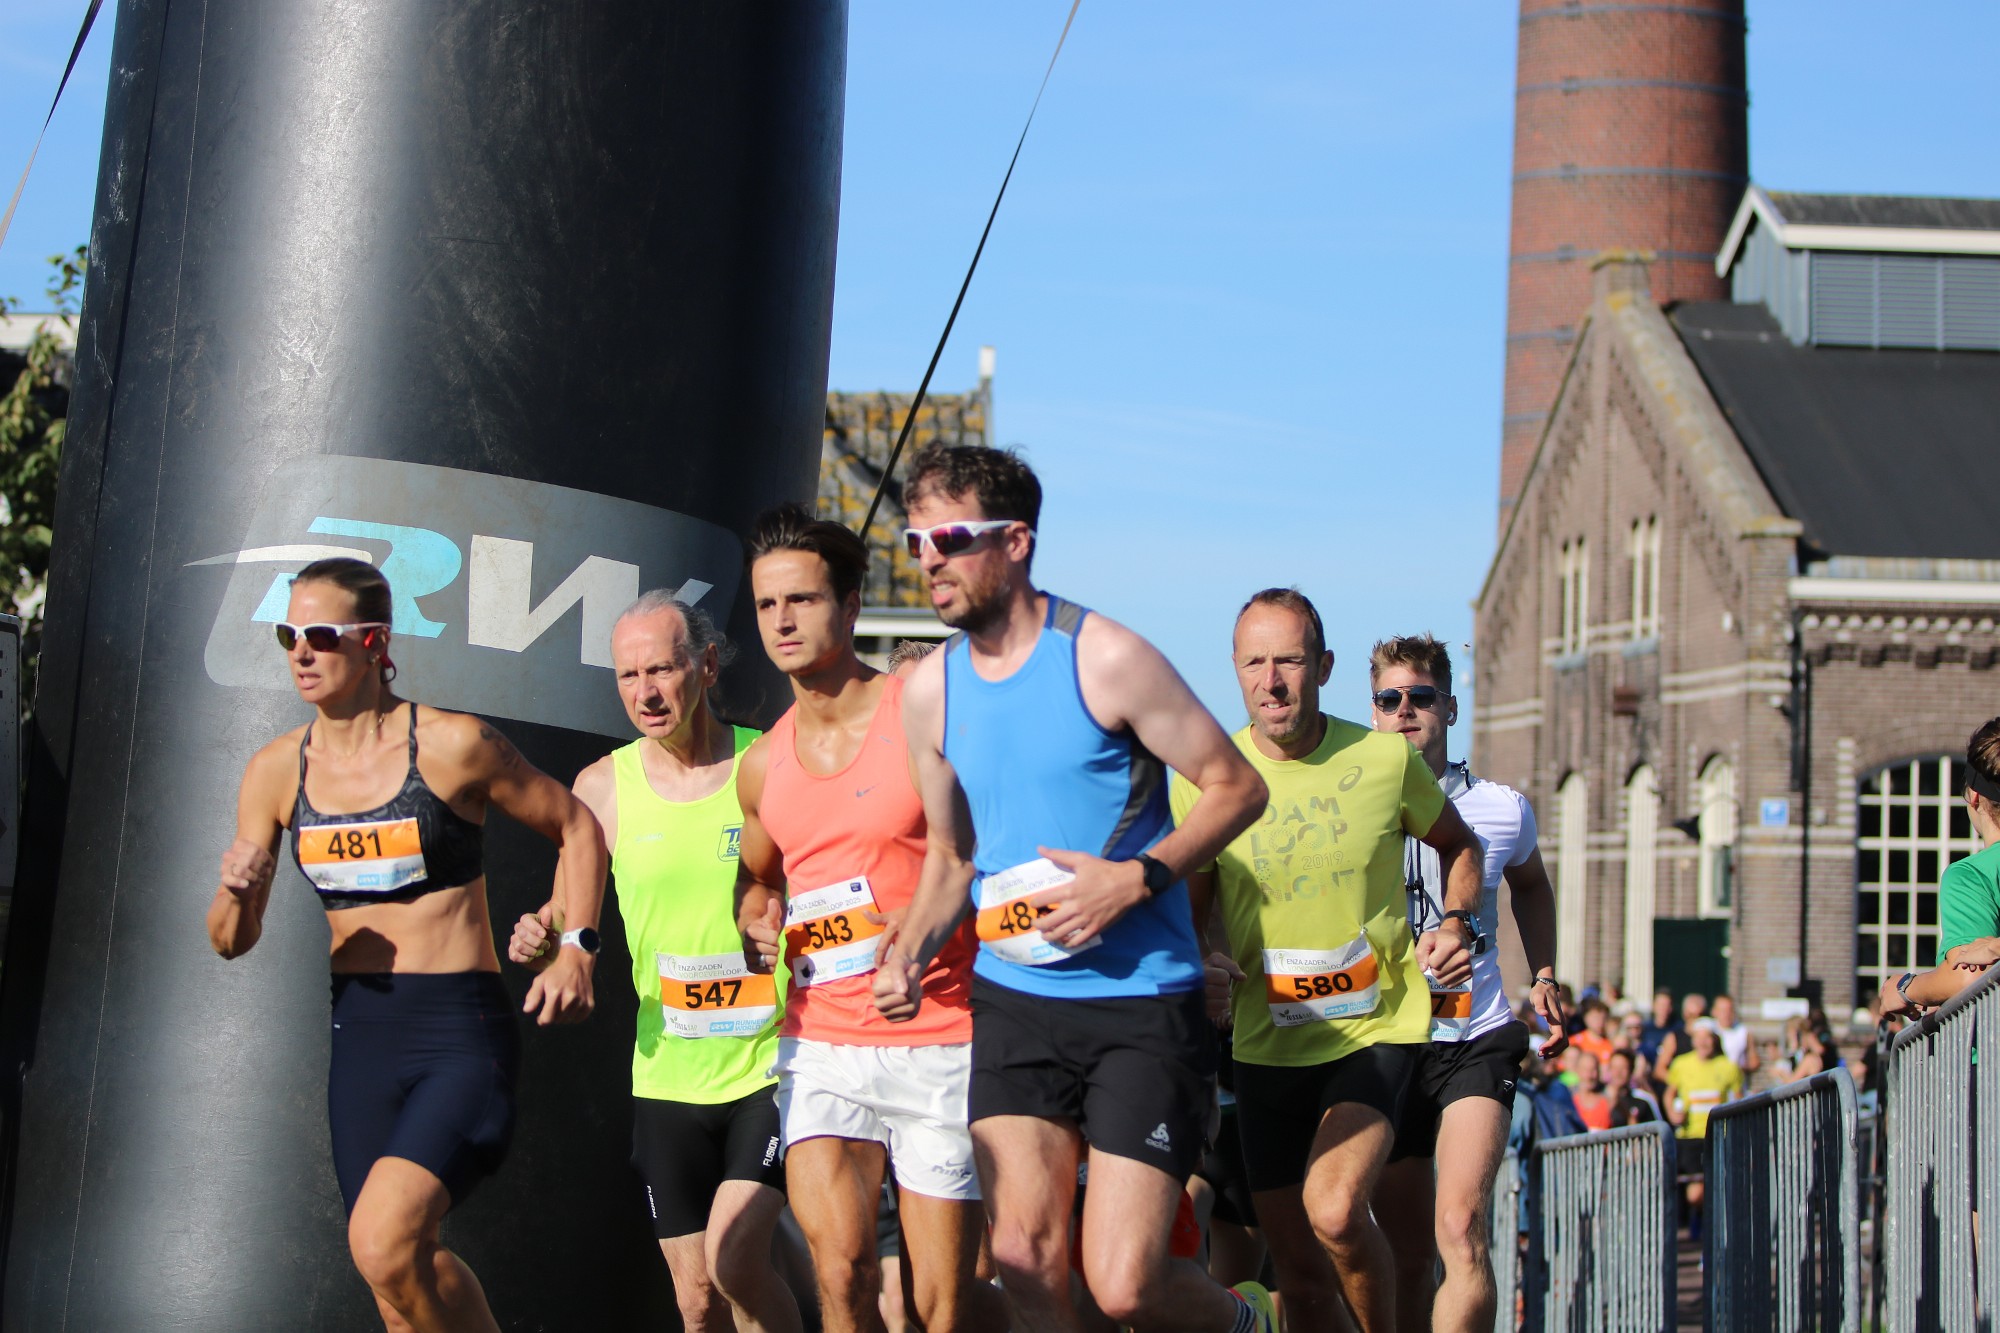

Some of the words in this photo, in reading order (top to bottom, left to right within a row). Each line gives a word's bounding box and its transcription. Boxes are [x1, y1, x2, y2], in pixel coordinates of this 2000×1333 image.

[248, 516, 713, 669] RW
[327, 829, 382, 859] 481
[1250, 818, 1348, 857] LOOP
[1302, 850, 1344, 870] 2019
[804, 915, 853, 949] 543
[1000, 901, 1040, 934] 48
[698, 963, 723, 971] ZADEN
[1286, 958, 1304, 966] ENZA
[685, 979, 743, 1009] 547
[1293, 972, 1353, 1000] 580
[762, 1135, 780, 1167] FUSION
